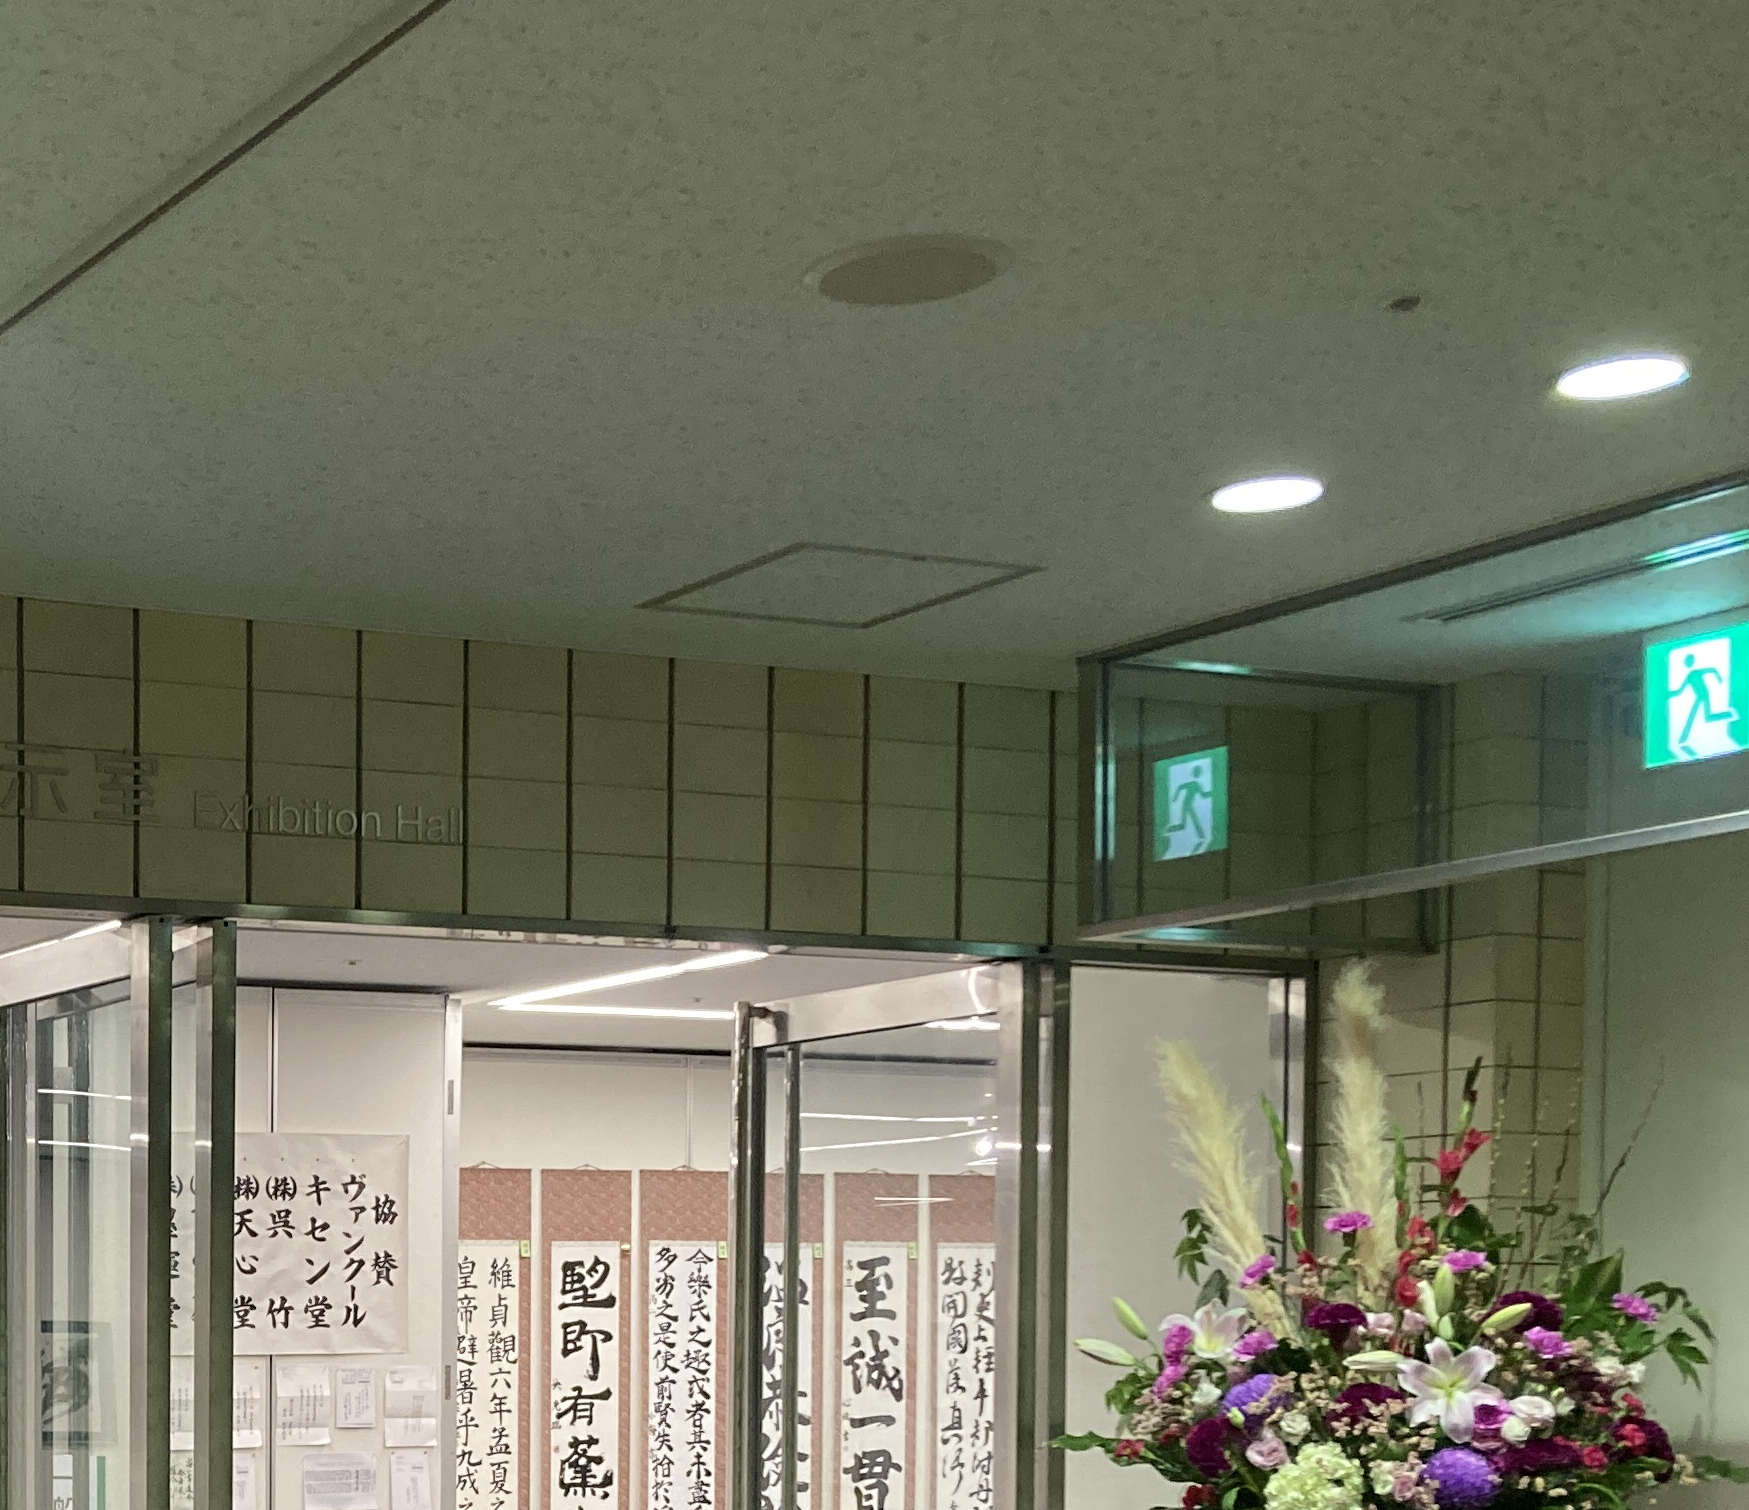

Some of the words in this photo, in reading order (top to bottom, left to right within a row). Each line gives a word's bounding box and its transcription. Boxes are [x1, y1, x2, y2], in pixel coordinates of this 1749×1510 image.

[193, 789, 381, 837] Exhibition
[397, 805, 464, 845] Hall
[303, 1174, 333, 1330] キセン堂
[341, 1173, 367, 1328] ヴァンクール
[371, 1193, 399, 1287] 協賛
